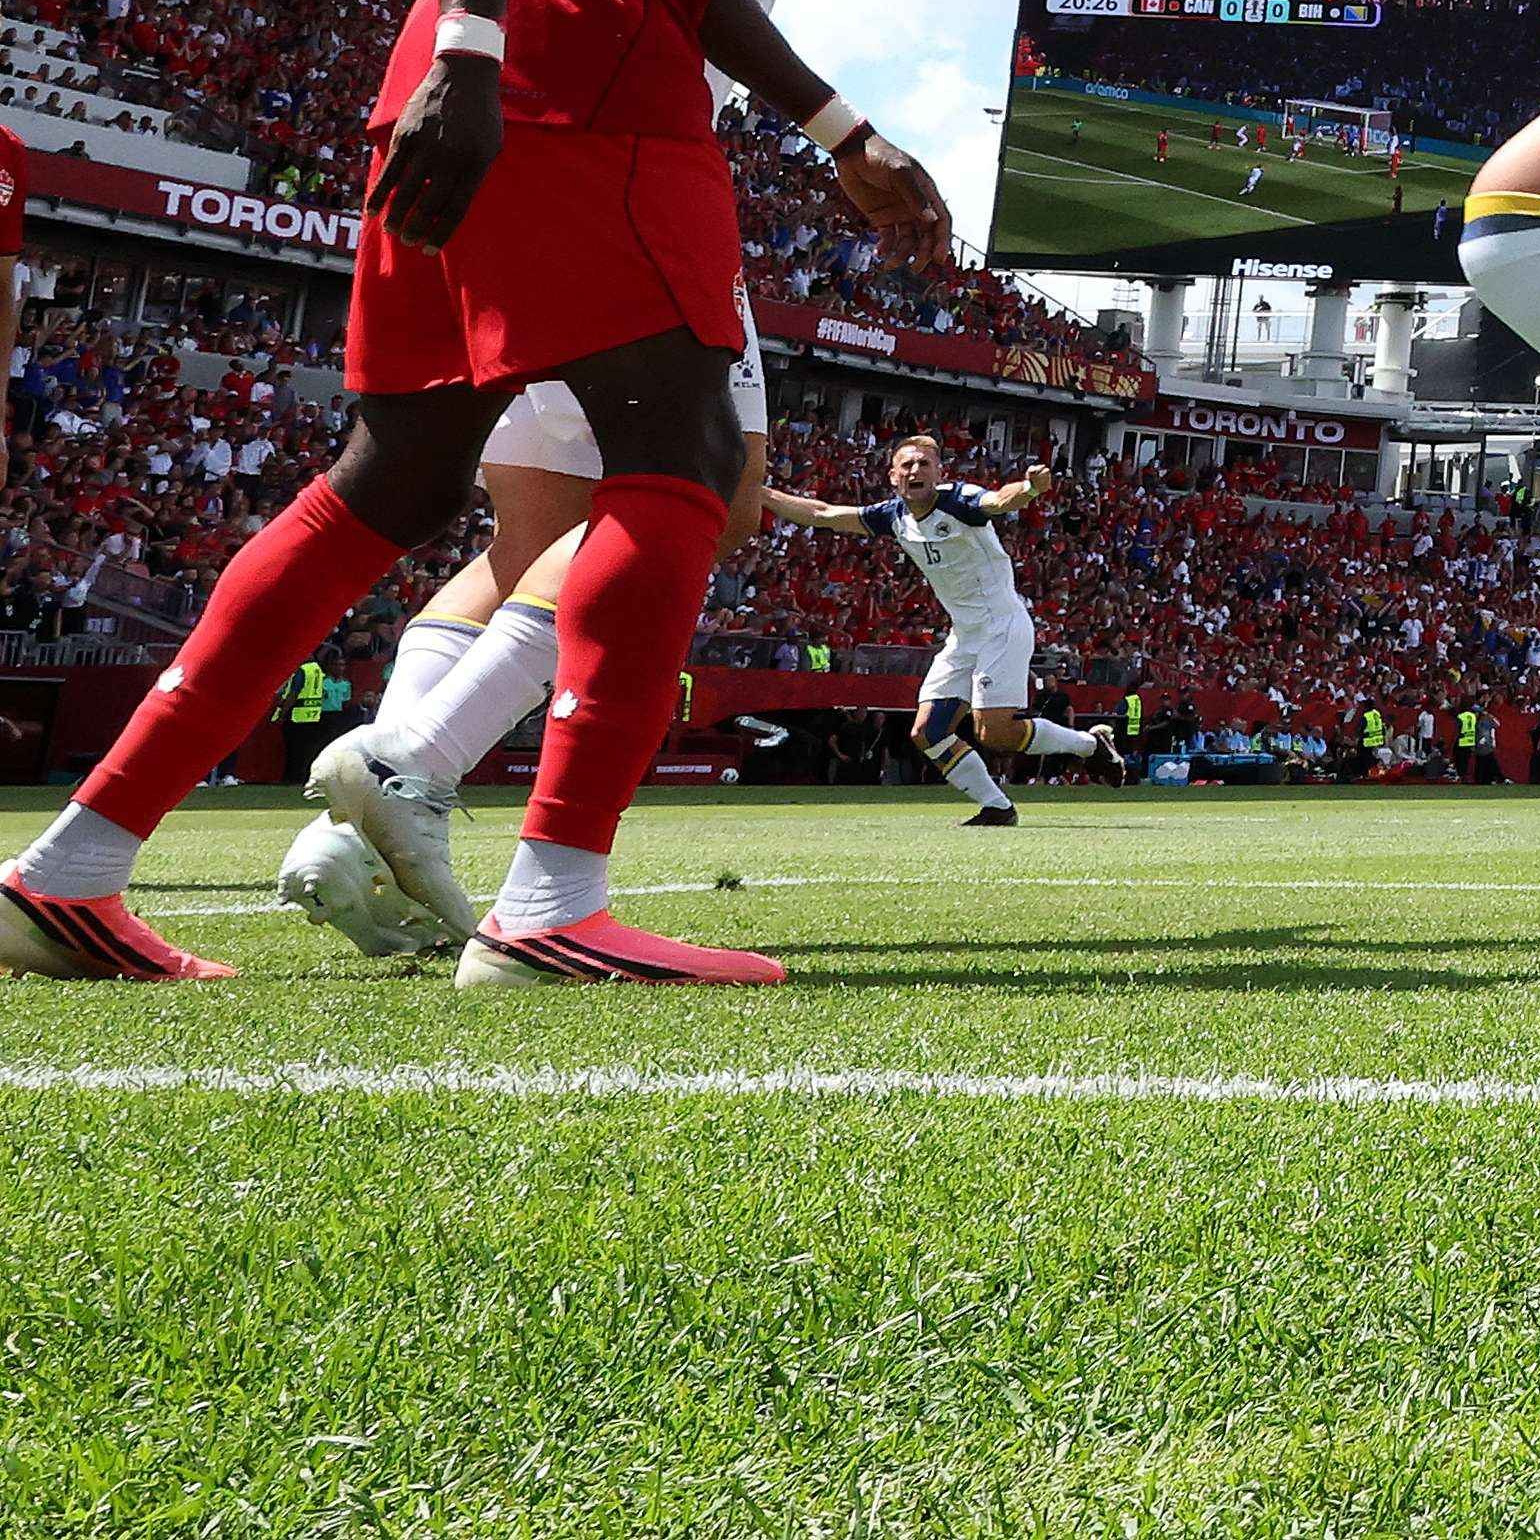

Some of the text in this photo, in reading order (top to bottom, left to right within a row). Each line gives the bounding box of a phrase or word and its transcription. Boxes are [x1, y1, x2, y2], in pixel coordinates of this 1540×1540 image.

[1298, 3, 1323, 19] BIH
[1084, 82, 1130, 100] aramco
[157, 180, 363, 250] TORONT
[1231, 258, 1334, 279] Hisense
[816, 317, 898, 356] #FIFAWorldCup
[1168, 402, 1346, 444] TORONTO
[922, 541, 942, 565] 15
